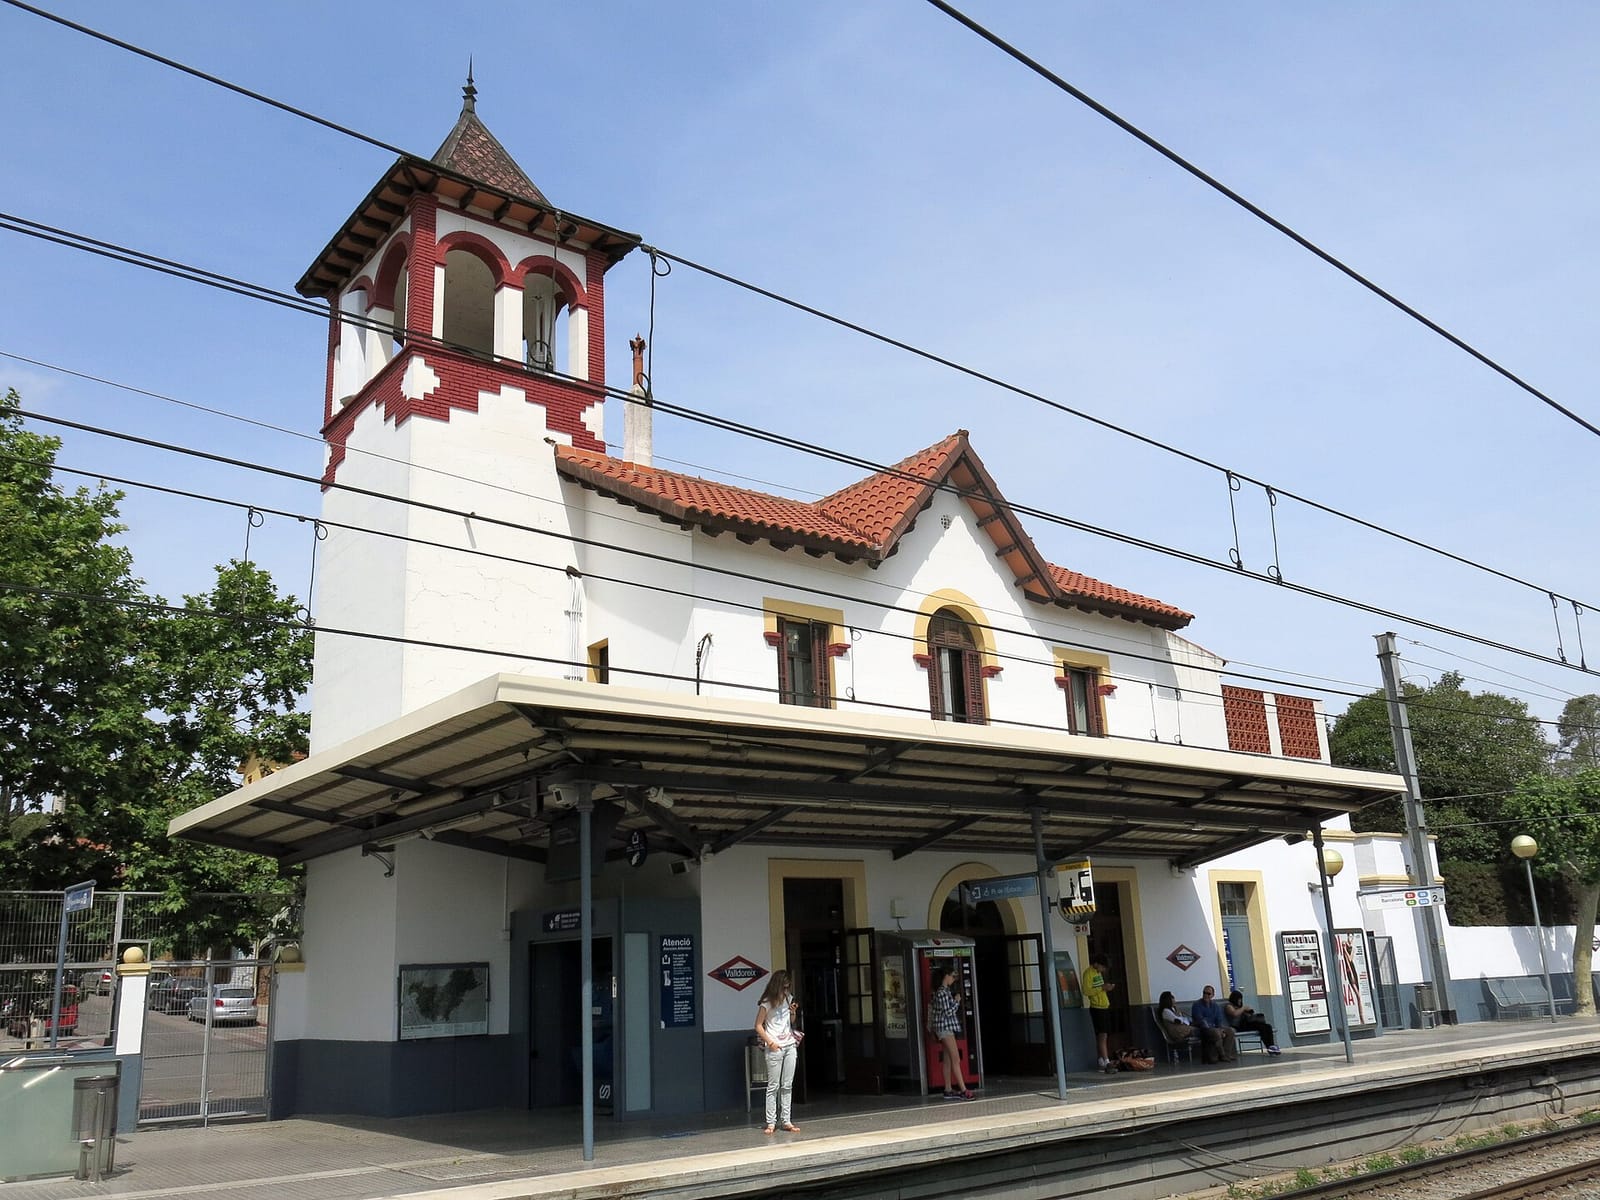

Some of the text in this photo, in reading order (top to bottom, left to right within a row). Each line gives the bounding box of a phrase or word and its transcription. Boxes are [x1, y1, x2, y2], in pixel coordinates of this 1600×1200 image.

[1432, 894, 1438, 902] 2
[662, 937, 691, 946] Atenció
[724, 968, 756, 977] Valldoreix
